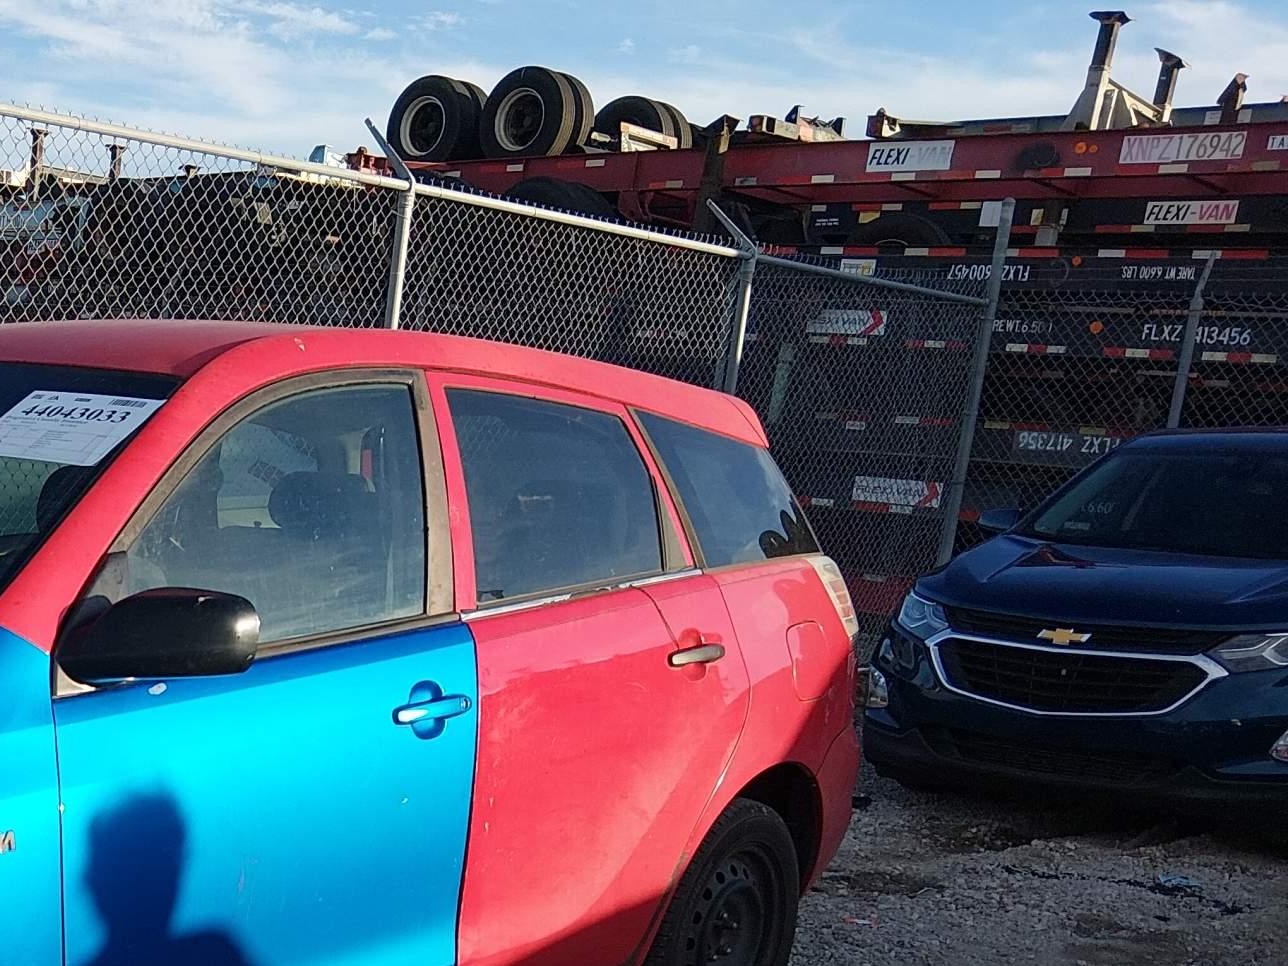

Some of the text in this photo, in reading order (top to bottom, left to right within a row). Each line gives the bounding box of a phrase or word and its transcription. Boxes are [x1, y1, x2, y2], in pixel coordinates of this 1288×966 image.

[1122, 133, 1245, 162] XNPZ176942
[1145, 203, 1236, 221] FLEXI-VAN
[1177, 266, 1196, 280] TARE
[1141, 323, 1183, 342] FLXZ
[21, 404, 131, 424] 44043033
[1018, 431, 1073, 452] 417356
